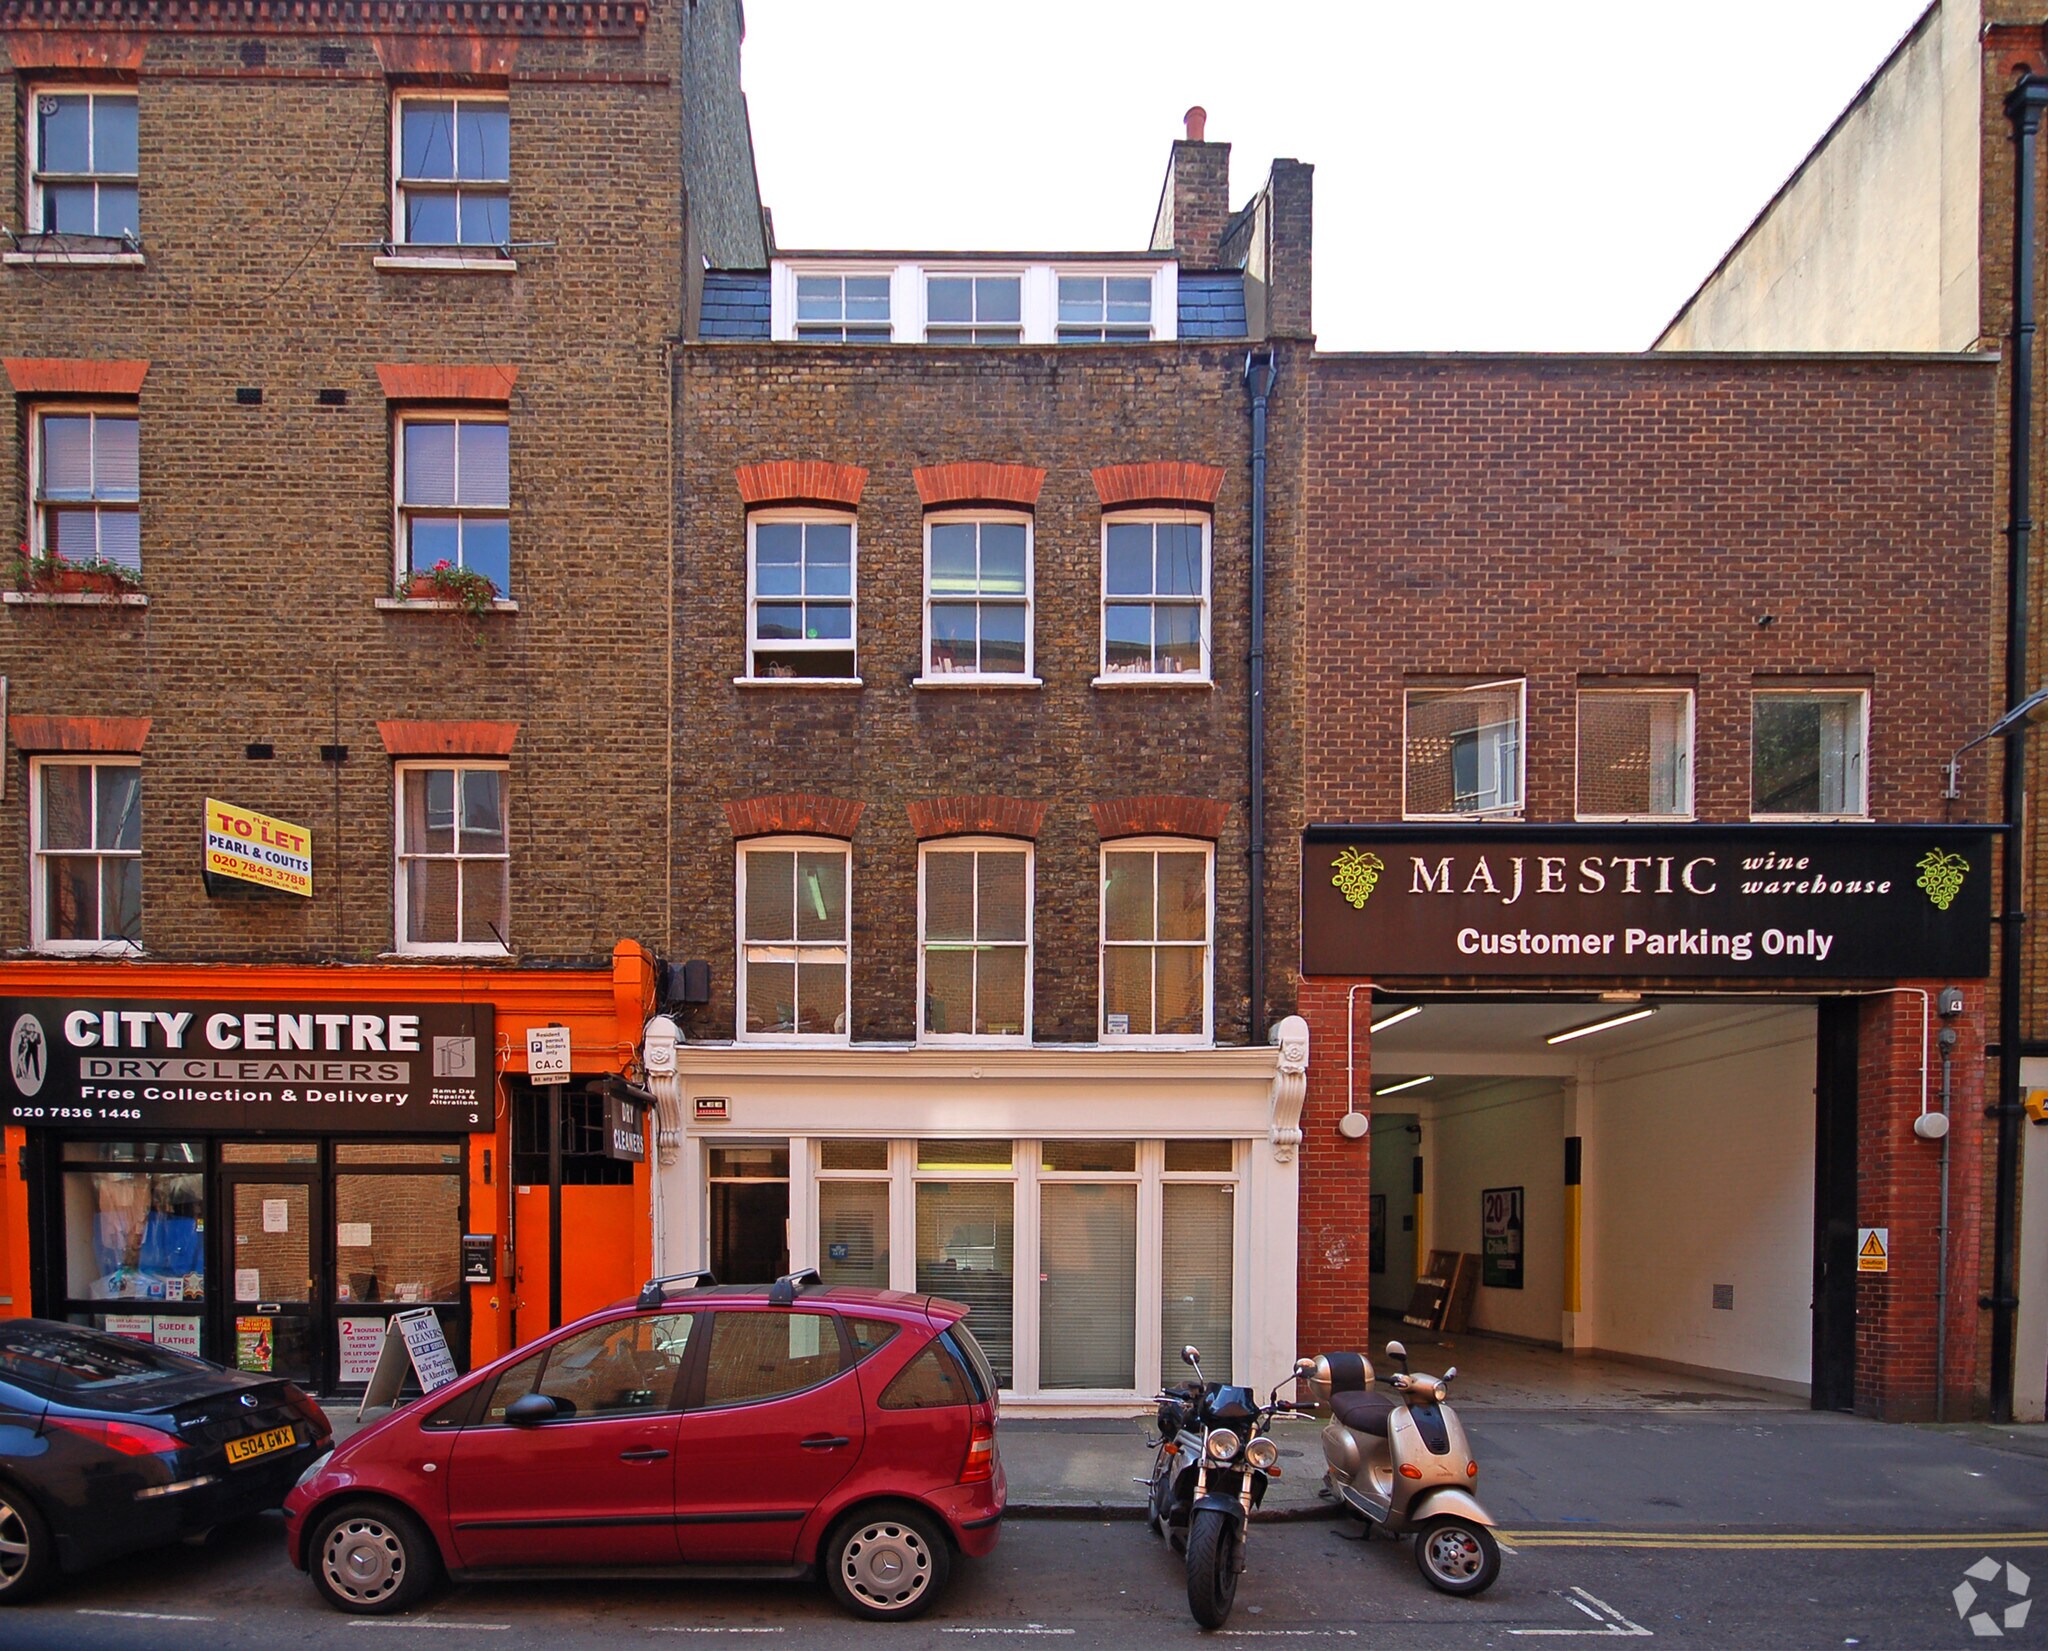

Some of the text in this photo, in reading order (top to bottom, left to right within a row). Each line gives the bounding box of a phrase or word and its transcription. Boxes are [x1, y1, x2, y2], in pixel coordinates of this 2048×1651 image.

[217, 813, 304, 852] TO LET
[209, 834, 309, 872] PEARL & COUTTS
[1740, 851, 1810, 871] wine
[213, 854, 306, 886] 020 7843 3788
[1408, 855, 1717, 905] MAJESTIC
[1740, 874, 1891, 894] warehouse
[1456, 927, 1834, 961] Customer Parking Only
[1953, 1001, 1959, 1009] 4
[64, 1010, 420, 1051] CITY CENTRE
[89, 1060, 400, 1082] DRY CLEANERS
[81, 1086, 409, 1106] Free Collection & Delivery
[458, 1088, 476, 1096] Day
[12, 1107, 142, 1119] 020 7836 1446
[468, 1113, 479, 1123] 3
[621, 1102, 634, 1124] DRY
[613, 1129, 644, 1155] CLEANERS
[1486, 1194, 1503, 1223] 20
[158, 1323, 195, 1331] SUEDE &
[342, 1321, 353, 1335] 2
[413, 1320, 428, 1331] DRY
[158, 1337, 195, 1345] LEATHER
[408, 1328, 443, 1345] CLEANERS
[231, 1428, 291, 1460] LS04 GWX
